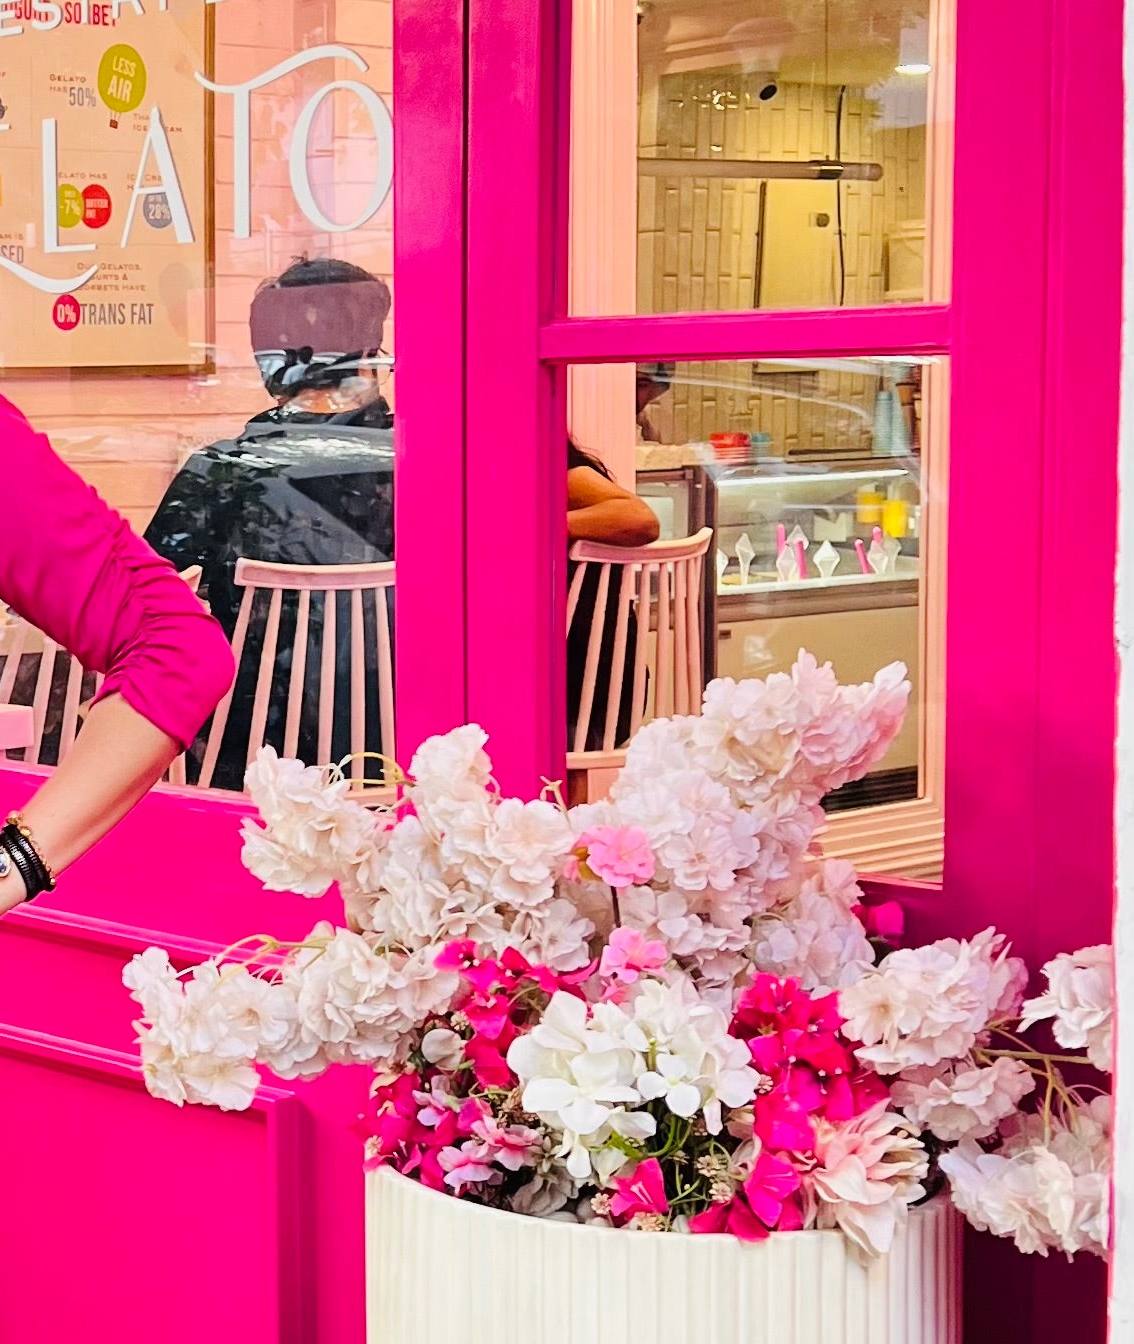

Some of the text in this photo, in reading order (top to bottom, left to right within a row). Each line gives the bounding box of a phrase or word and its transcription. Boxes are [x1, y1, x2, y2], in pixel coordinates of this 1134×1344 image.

[64, 2, 116, 27] SOBE
[112, 56, 136, 77] LESS
[49, 73, 86, 83] GELATO
[69, 87, 97, 107] 50%
[107, 75, 133, 103] AIR
[58, 171, 85, 179] ELATO
[56, 302, 154, 325] 0% TRANS FAT
